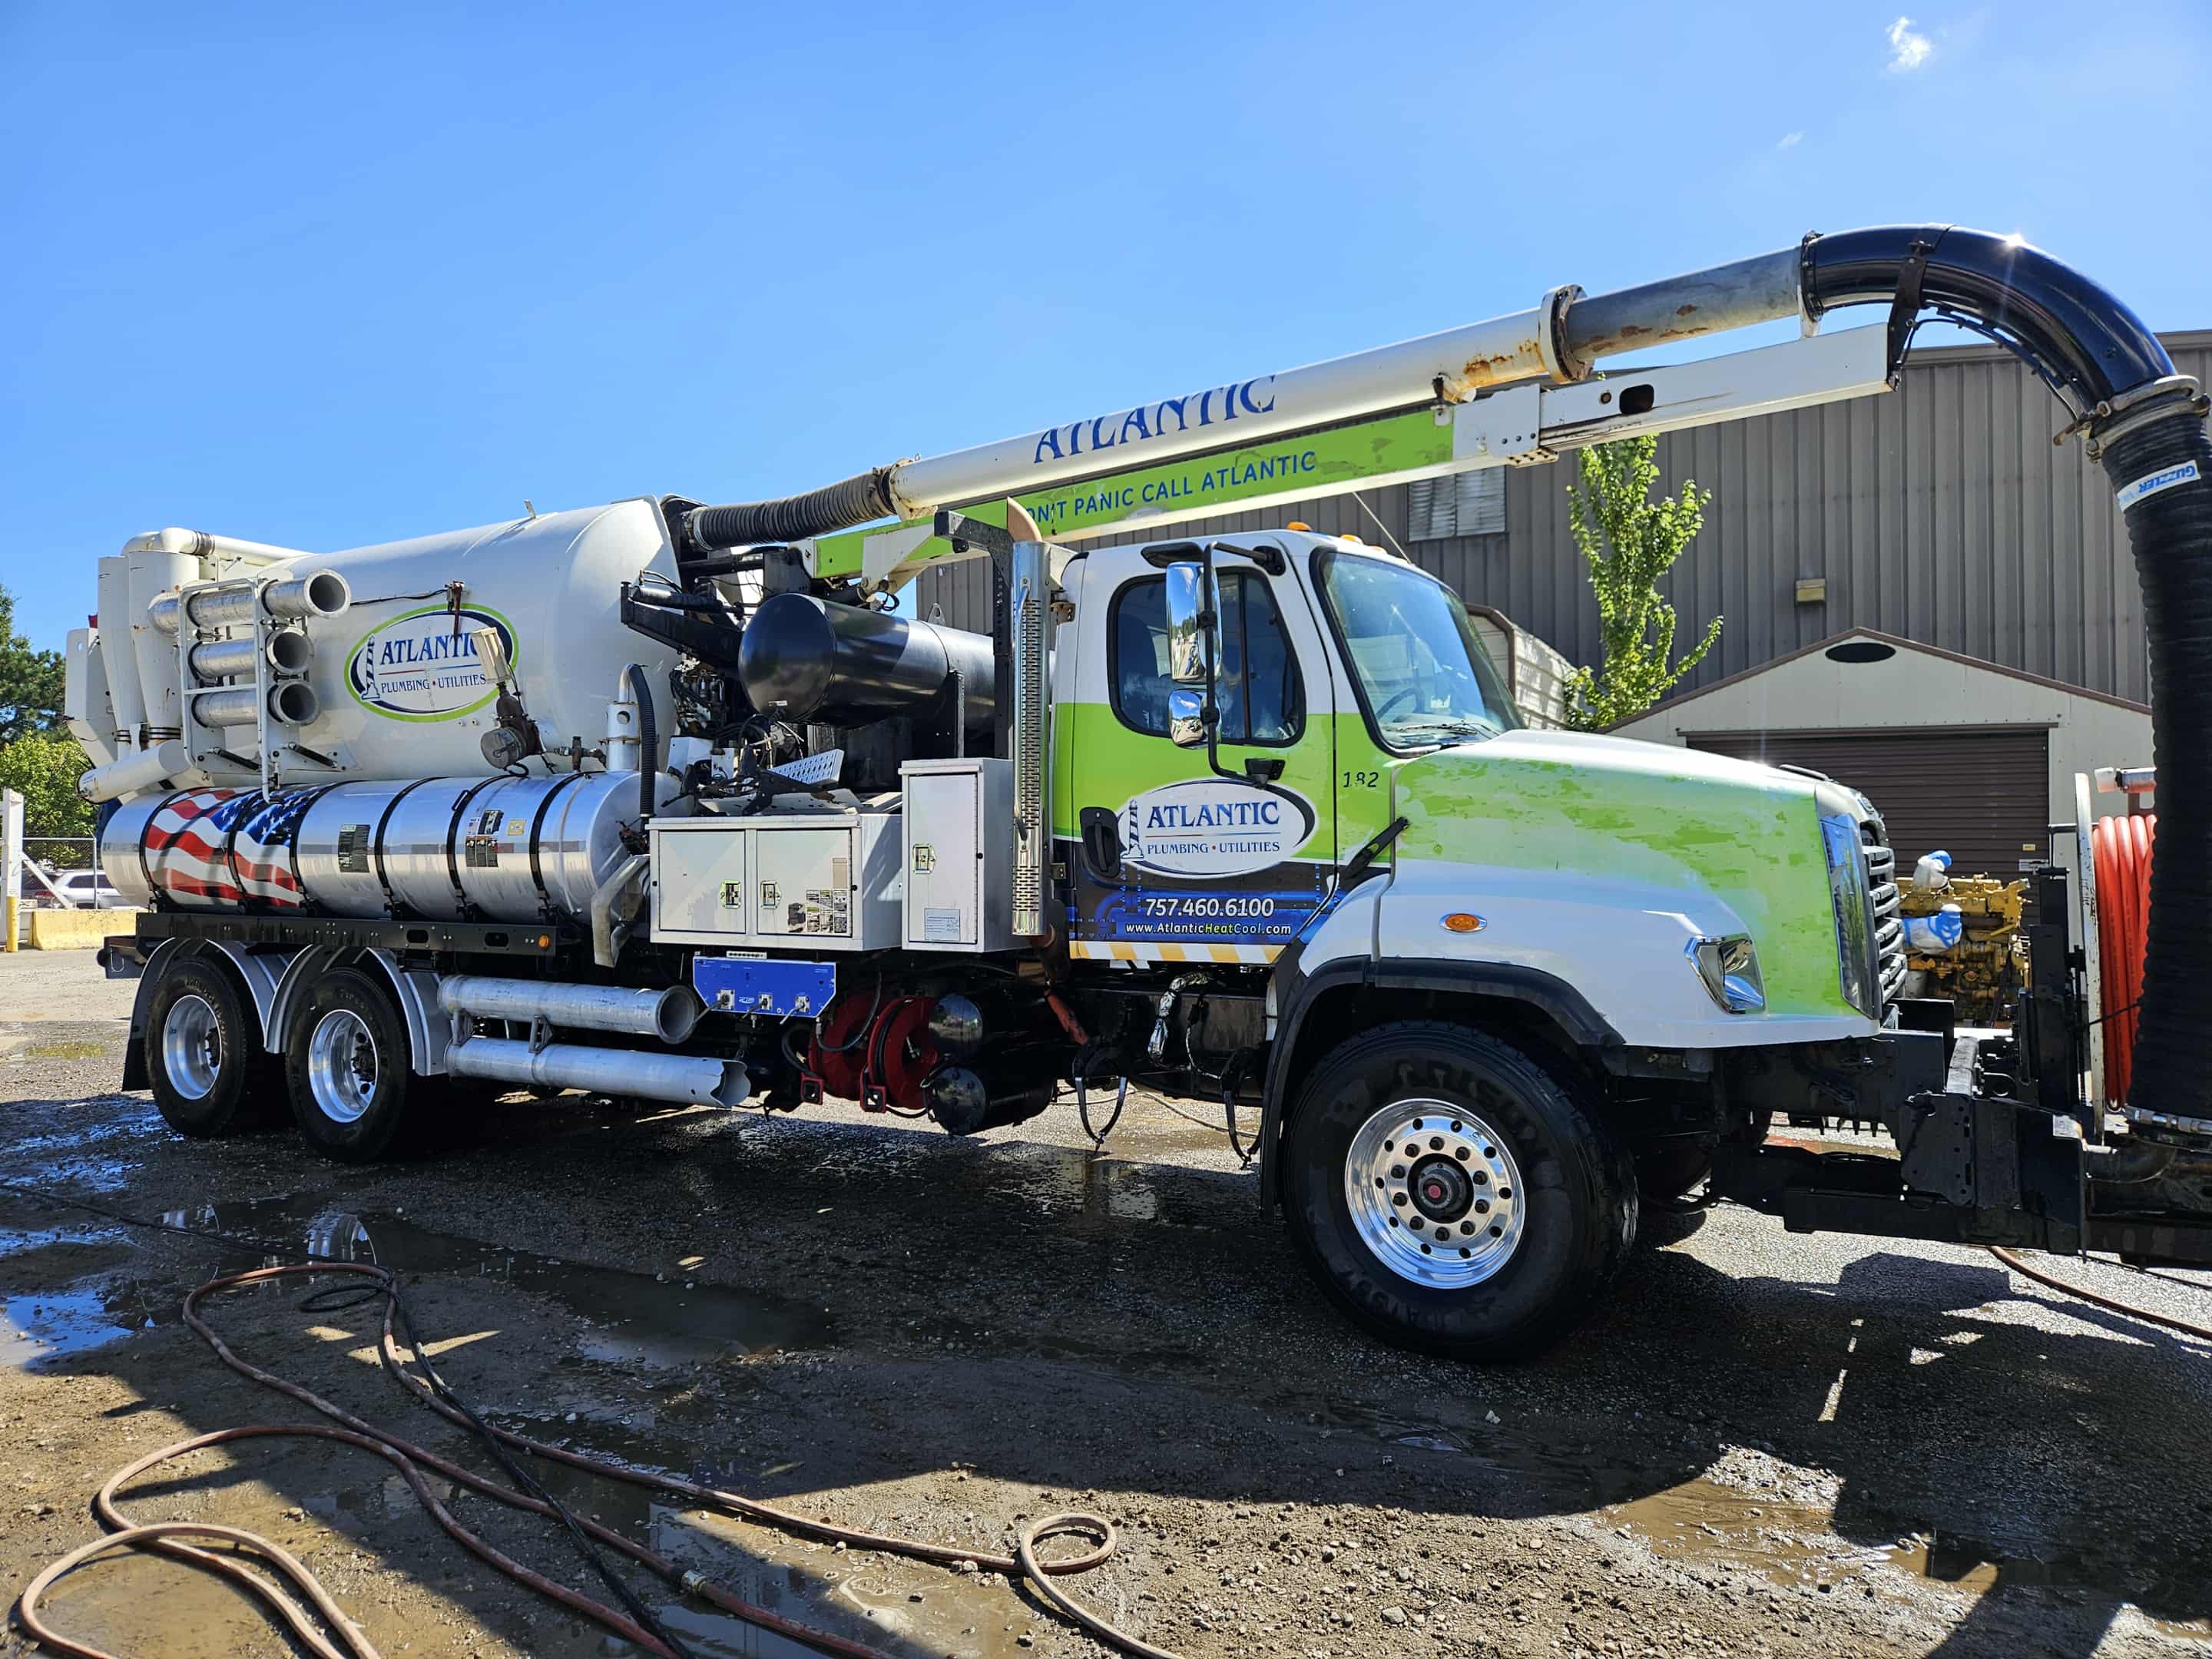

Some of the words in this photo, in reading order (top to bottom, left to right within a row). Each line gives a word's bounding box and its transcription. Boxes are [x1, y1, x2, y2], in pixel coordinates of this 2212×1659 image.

[1034, 374, 1277, 463] ATLANTIC
[1026, 501, 1067, 522] ON'T
[1075, 487, 1134, 516] PANIC
[1141, 476, 1193, 503] CALL
[1201, 451, 1316, 491] ATLANTIC
[2138, 465, 2196, 493] GUZZLER
[381, 679, 430, 693] PLUMBING
[438, 674, 486, 688] UTILITIES
[1147, 800, 1280, 828] ATLANTIC
[1147, 843, 1208, 855] PLUMBING
[1219, 841, 1280, 853] UTILITIES
[1145, 898, 1274, 916] 757.460.6100
[1125, 922, 1291, 935] www.AtlanticHeatCool.com
